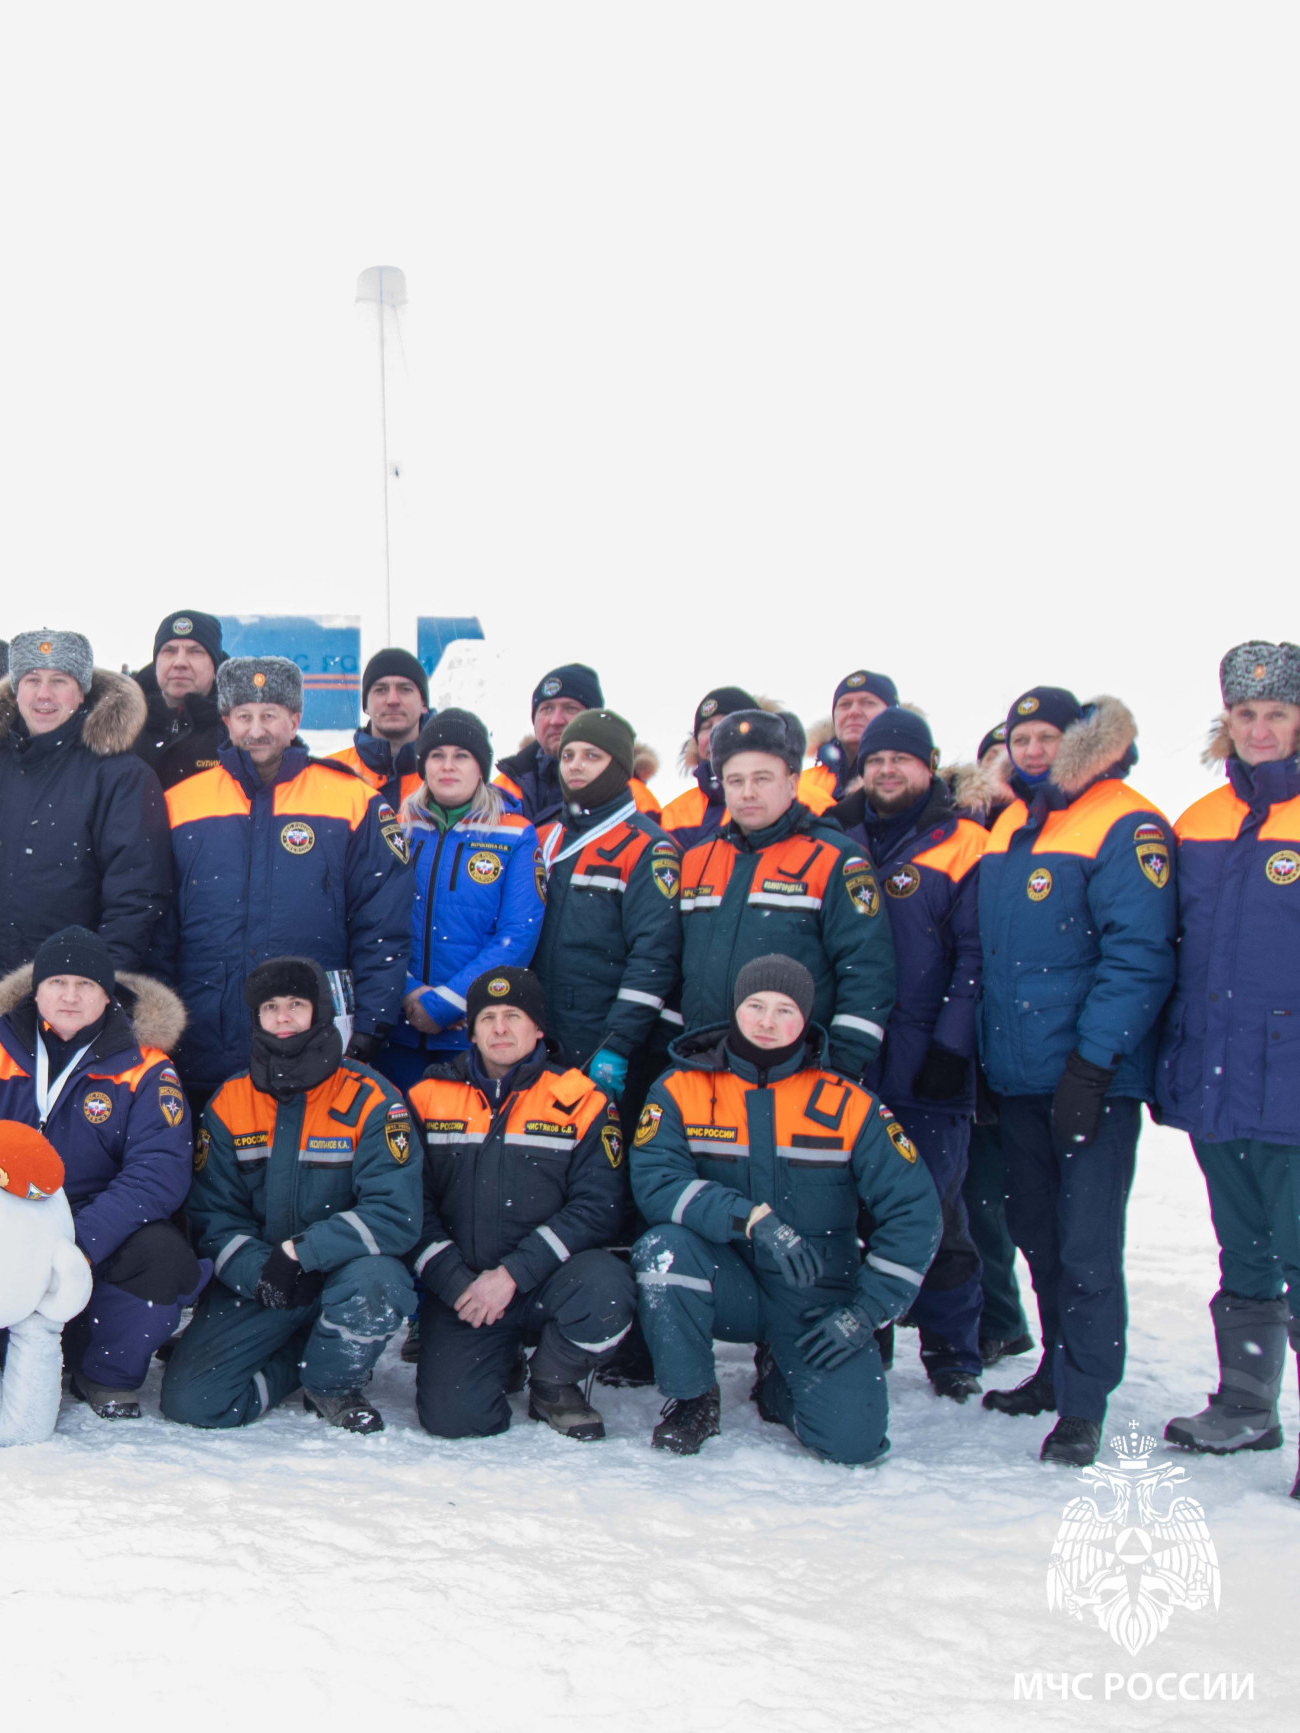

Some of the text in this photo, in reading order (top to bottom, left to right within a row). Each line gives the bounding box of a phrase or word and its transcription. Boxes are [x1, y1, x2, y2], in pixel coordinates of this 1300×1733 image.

[426, 1122, 464, 1131] МЧС РОССИИ
[526, 1122, 559, 1133] ЧИСТЯКОВ
[686, 1127, 735, 1139] МЧС РОССИИ
